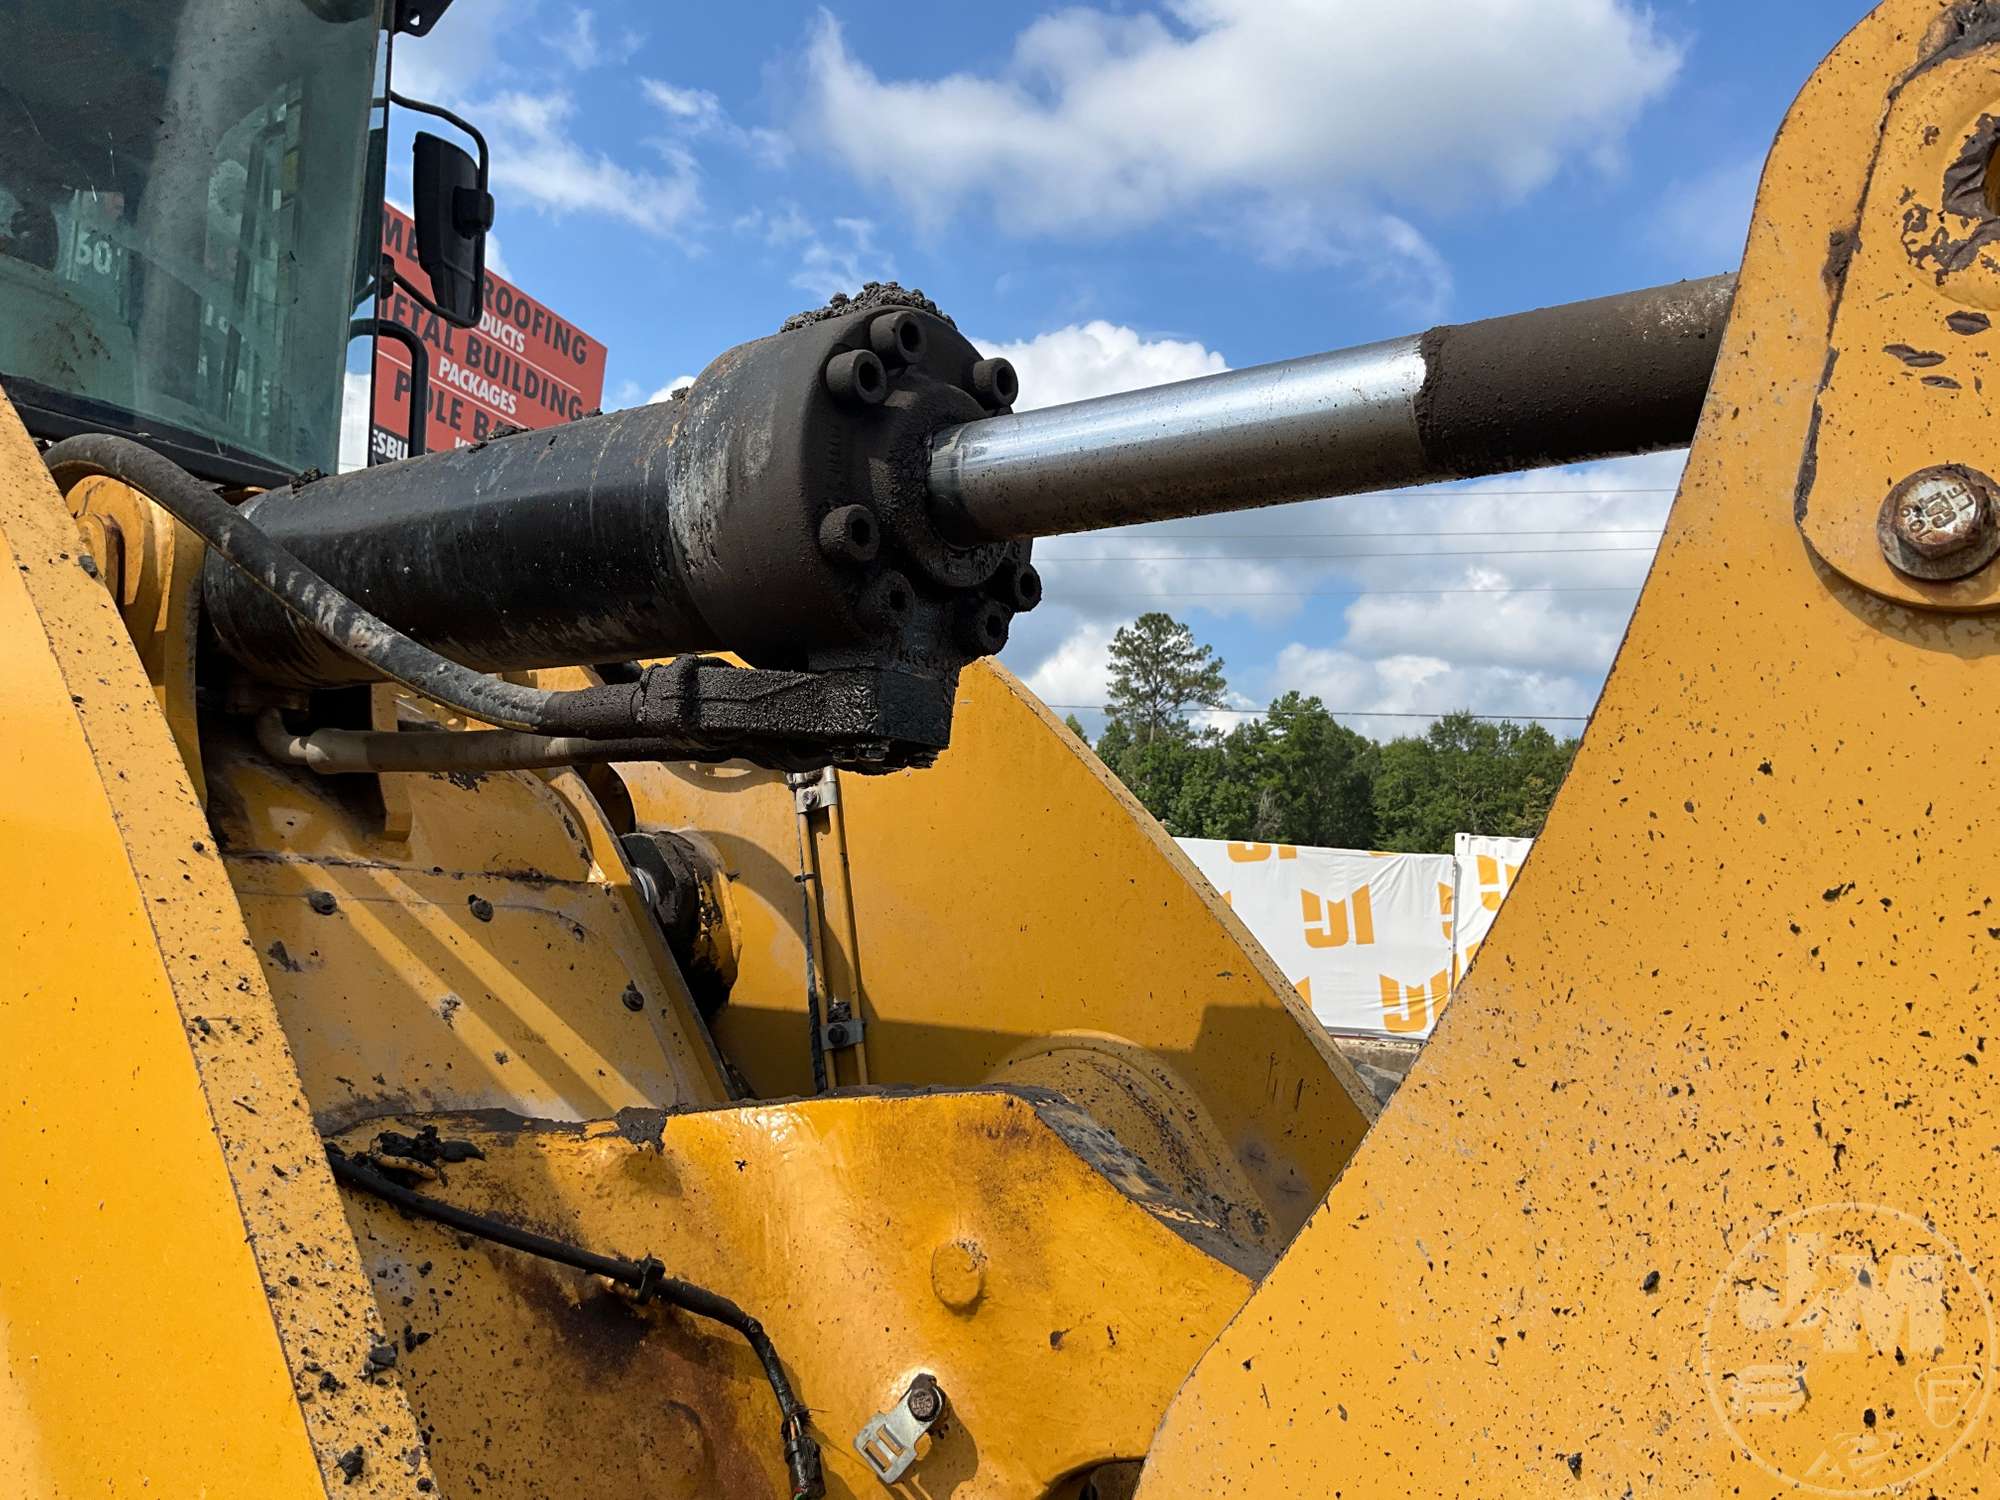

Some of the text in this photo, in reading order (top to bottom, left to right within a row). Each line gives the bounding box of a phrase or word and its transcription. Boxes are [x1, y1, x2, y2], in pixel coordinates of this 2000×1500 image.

[483, 276, 587, 366] ROOFING
[438, 356, 518, 416] PACKAGES
[465, 334, 584, 422] BUILDING
